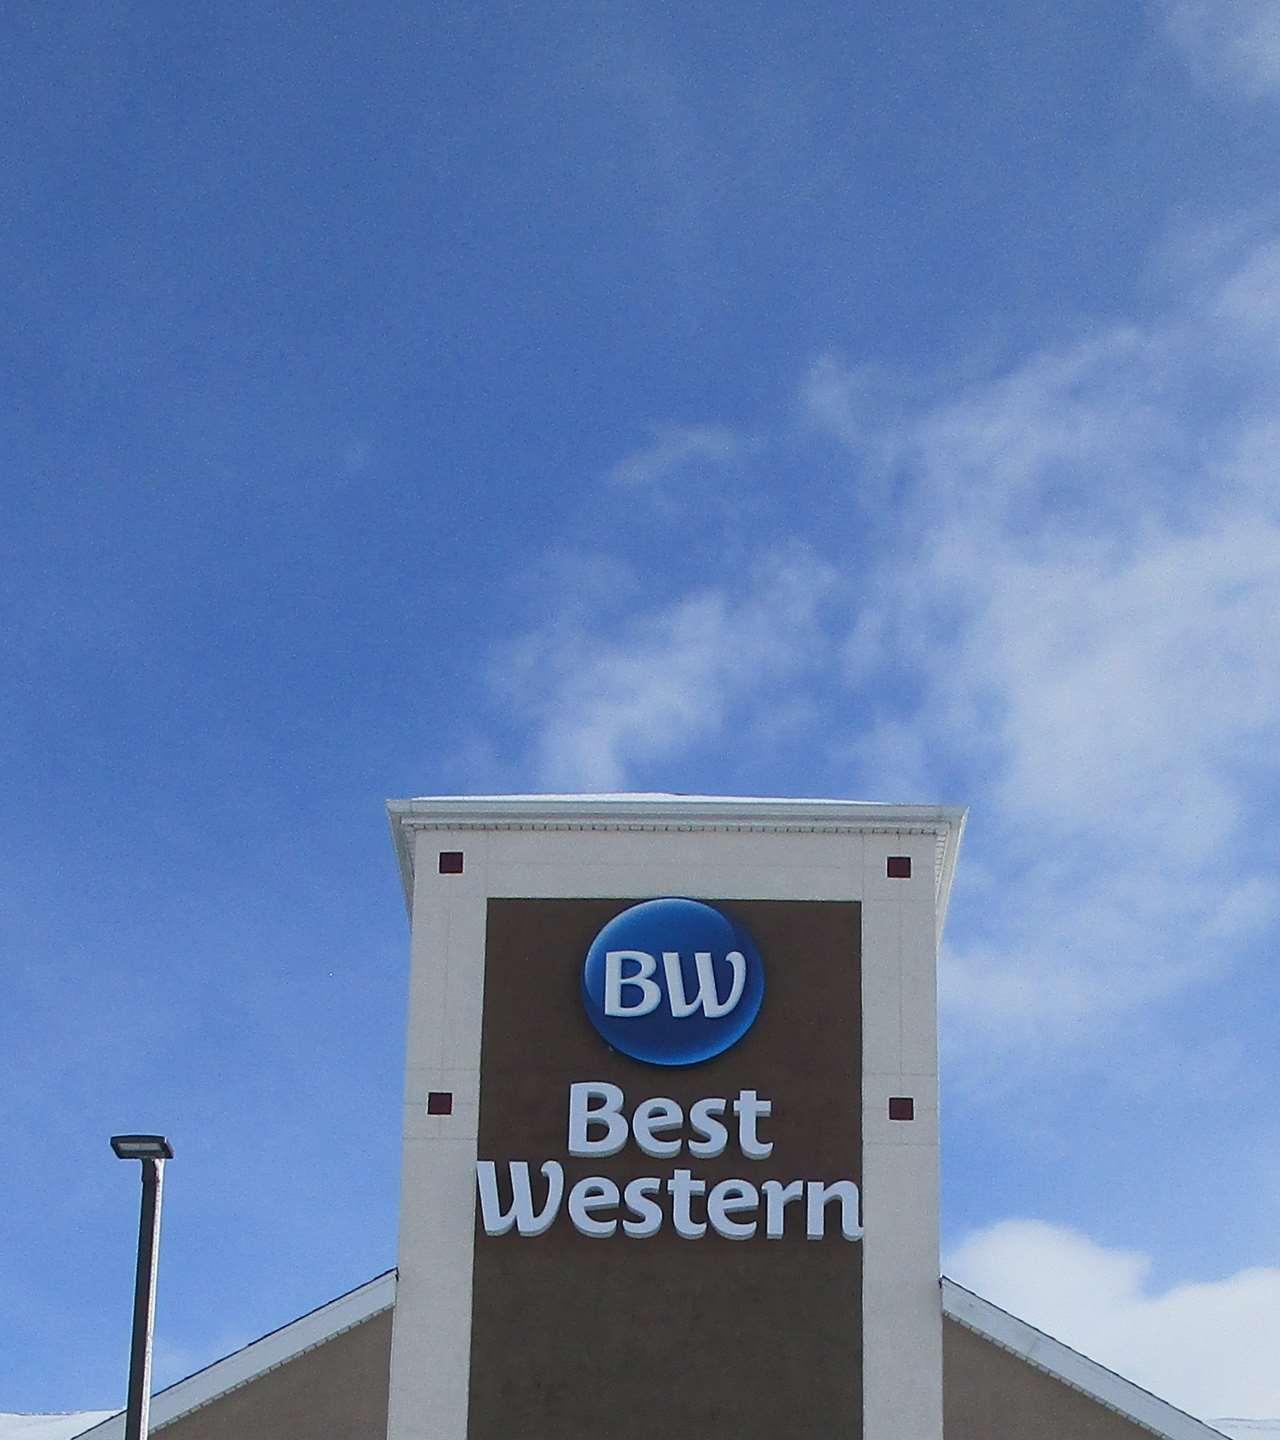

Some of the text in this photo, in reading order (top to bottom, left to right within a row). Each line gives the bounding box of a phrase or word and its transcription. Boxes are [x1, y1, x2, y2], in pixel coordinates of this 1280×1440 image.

[604, 950, 747, 1019] BW
[567, 1081, 774, 1160] Best
[476, 1159, 865, 1241] Western
